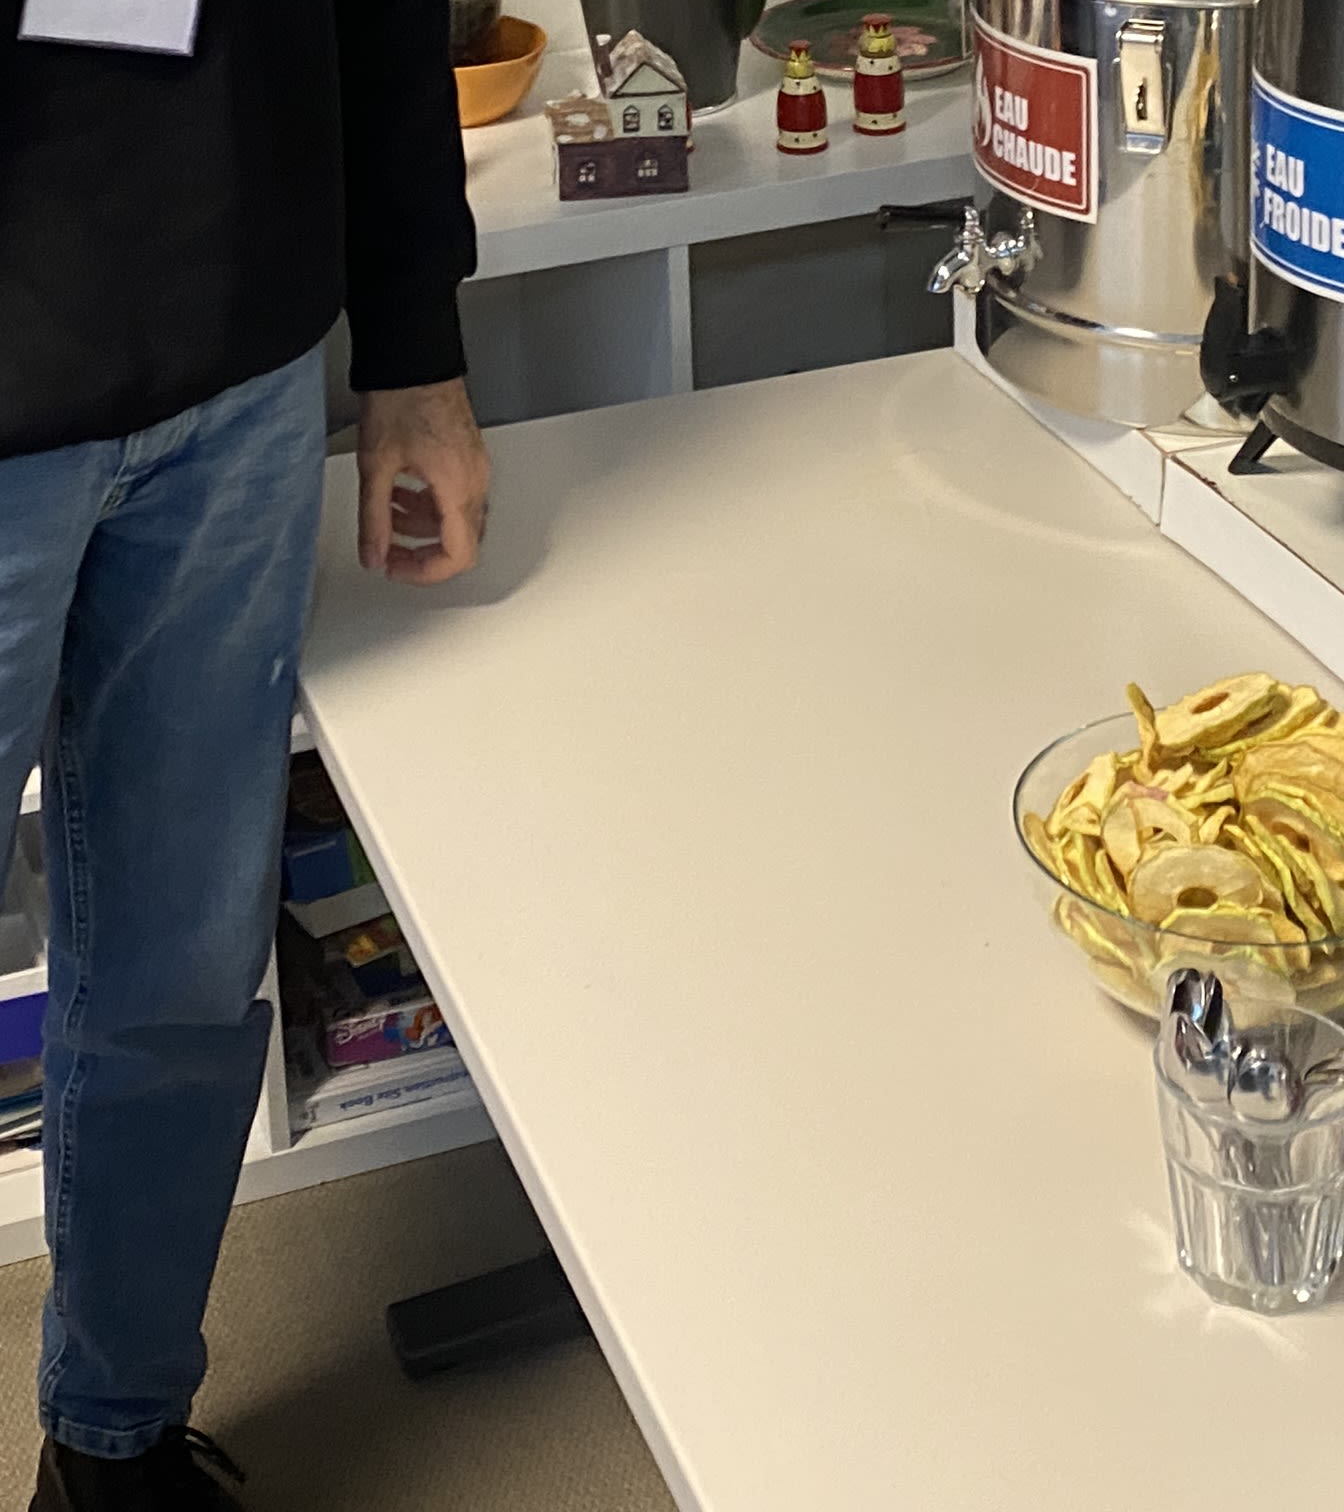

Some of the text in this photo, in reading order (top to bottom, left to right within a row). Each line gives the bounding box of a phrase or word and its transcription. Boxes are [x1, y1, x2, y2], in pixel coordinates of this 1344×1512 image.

[994, 85, 1028, 131] EAU
[992, 123, 1077, 186] CHAUDE
[1266, 143, 1305, 198] EAU
